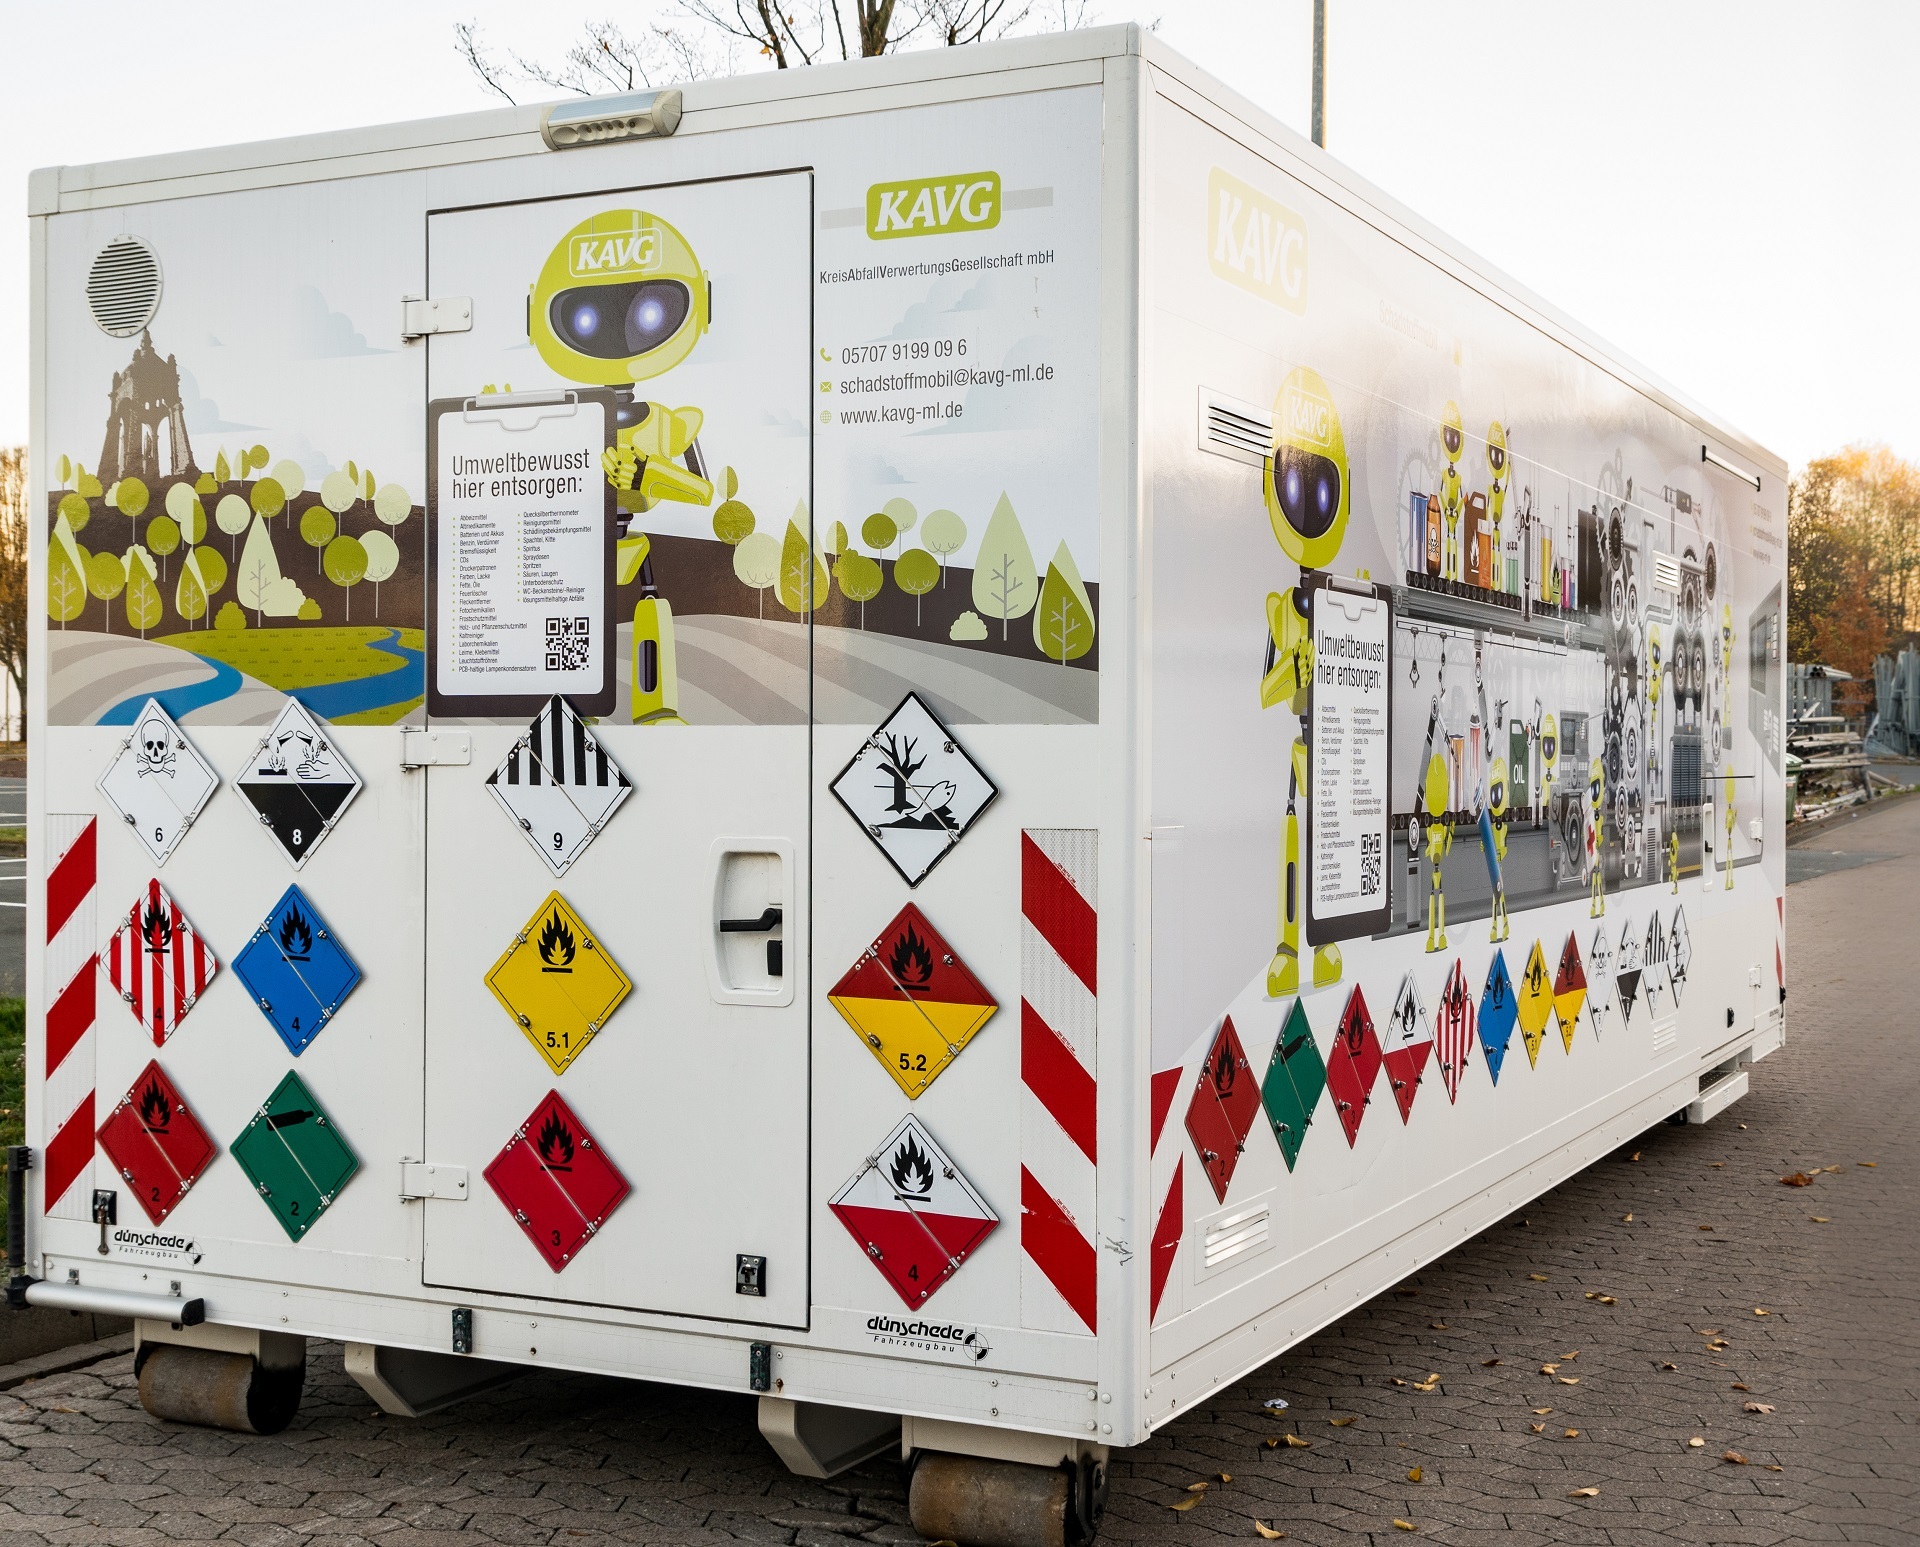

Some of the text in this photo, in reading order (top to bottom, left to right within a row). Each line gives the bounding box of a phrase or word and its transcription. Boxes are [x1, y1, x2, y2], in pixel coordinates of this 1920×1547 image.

[874, 181, 993, 232] KAVG
[1214, 188, 1303, 298] KAVG
[576, 236, 654, 271] KAVG
[820, 250, 1054, 284] KreisAbfallVerwertungsGesellschaft mbH
[842, 338, 967, 364] 05707 9199 09 6
[840, 363, 1054, 394] schadstoffmobil@kavg-ml.de
[840, 401, 963, 424] www.kavg-ml.de
[1290, 396, 1327, 438] KAVG
[452, 449, 590, 476] Umweltbewusst
[452, 475, 582, 499] hier entsorgen:
[523, 553, 549, 561] Spraydosen
[1318, 630, 1384, 662] Umweltbewusst
[1318, 659, 1380, 693] hier entsorgen:
[1513, 764, 1525, 784] OIL
[155, 827, 163, 842] 6
[292, 829, 302, 845] 8
[553, 832, 563, 849] 9
[154, 1006, 163, 1021] 4
[291, 1017, 300, 1032] 4
[546, 1032, 569, 1049] 5.1
[899, 1053, 927, 1072] 5.2
[1290, 1130, 1296, 1146] 2
[1219, 1160, 1225, 1176] 2
[151, 1188, 160, 1202] 2
[290, 1202, 299, 1217] 2
[551, 1230, 561, 1247] 3
[119, 1247, 178, 1260] Fahrzeugbau
[907, 1264, 919, 1282] 4
[873, 1335, 955, 1352] Fahrzeugbau
